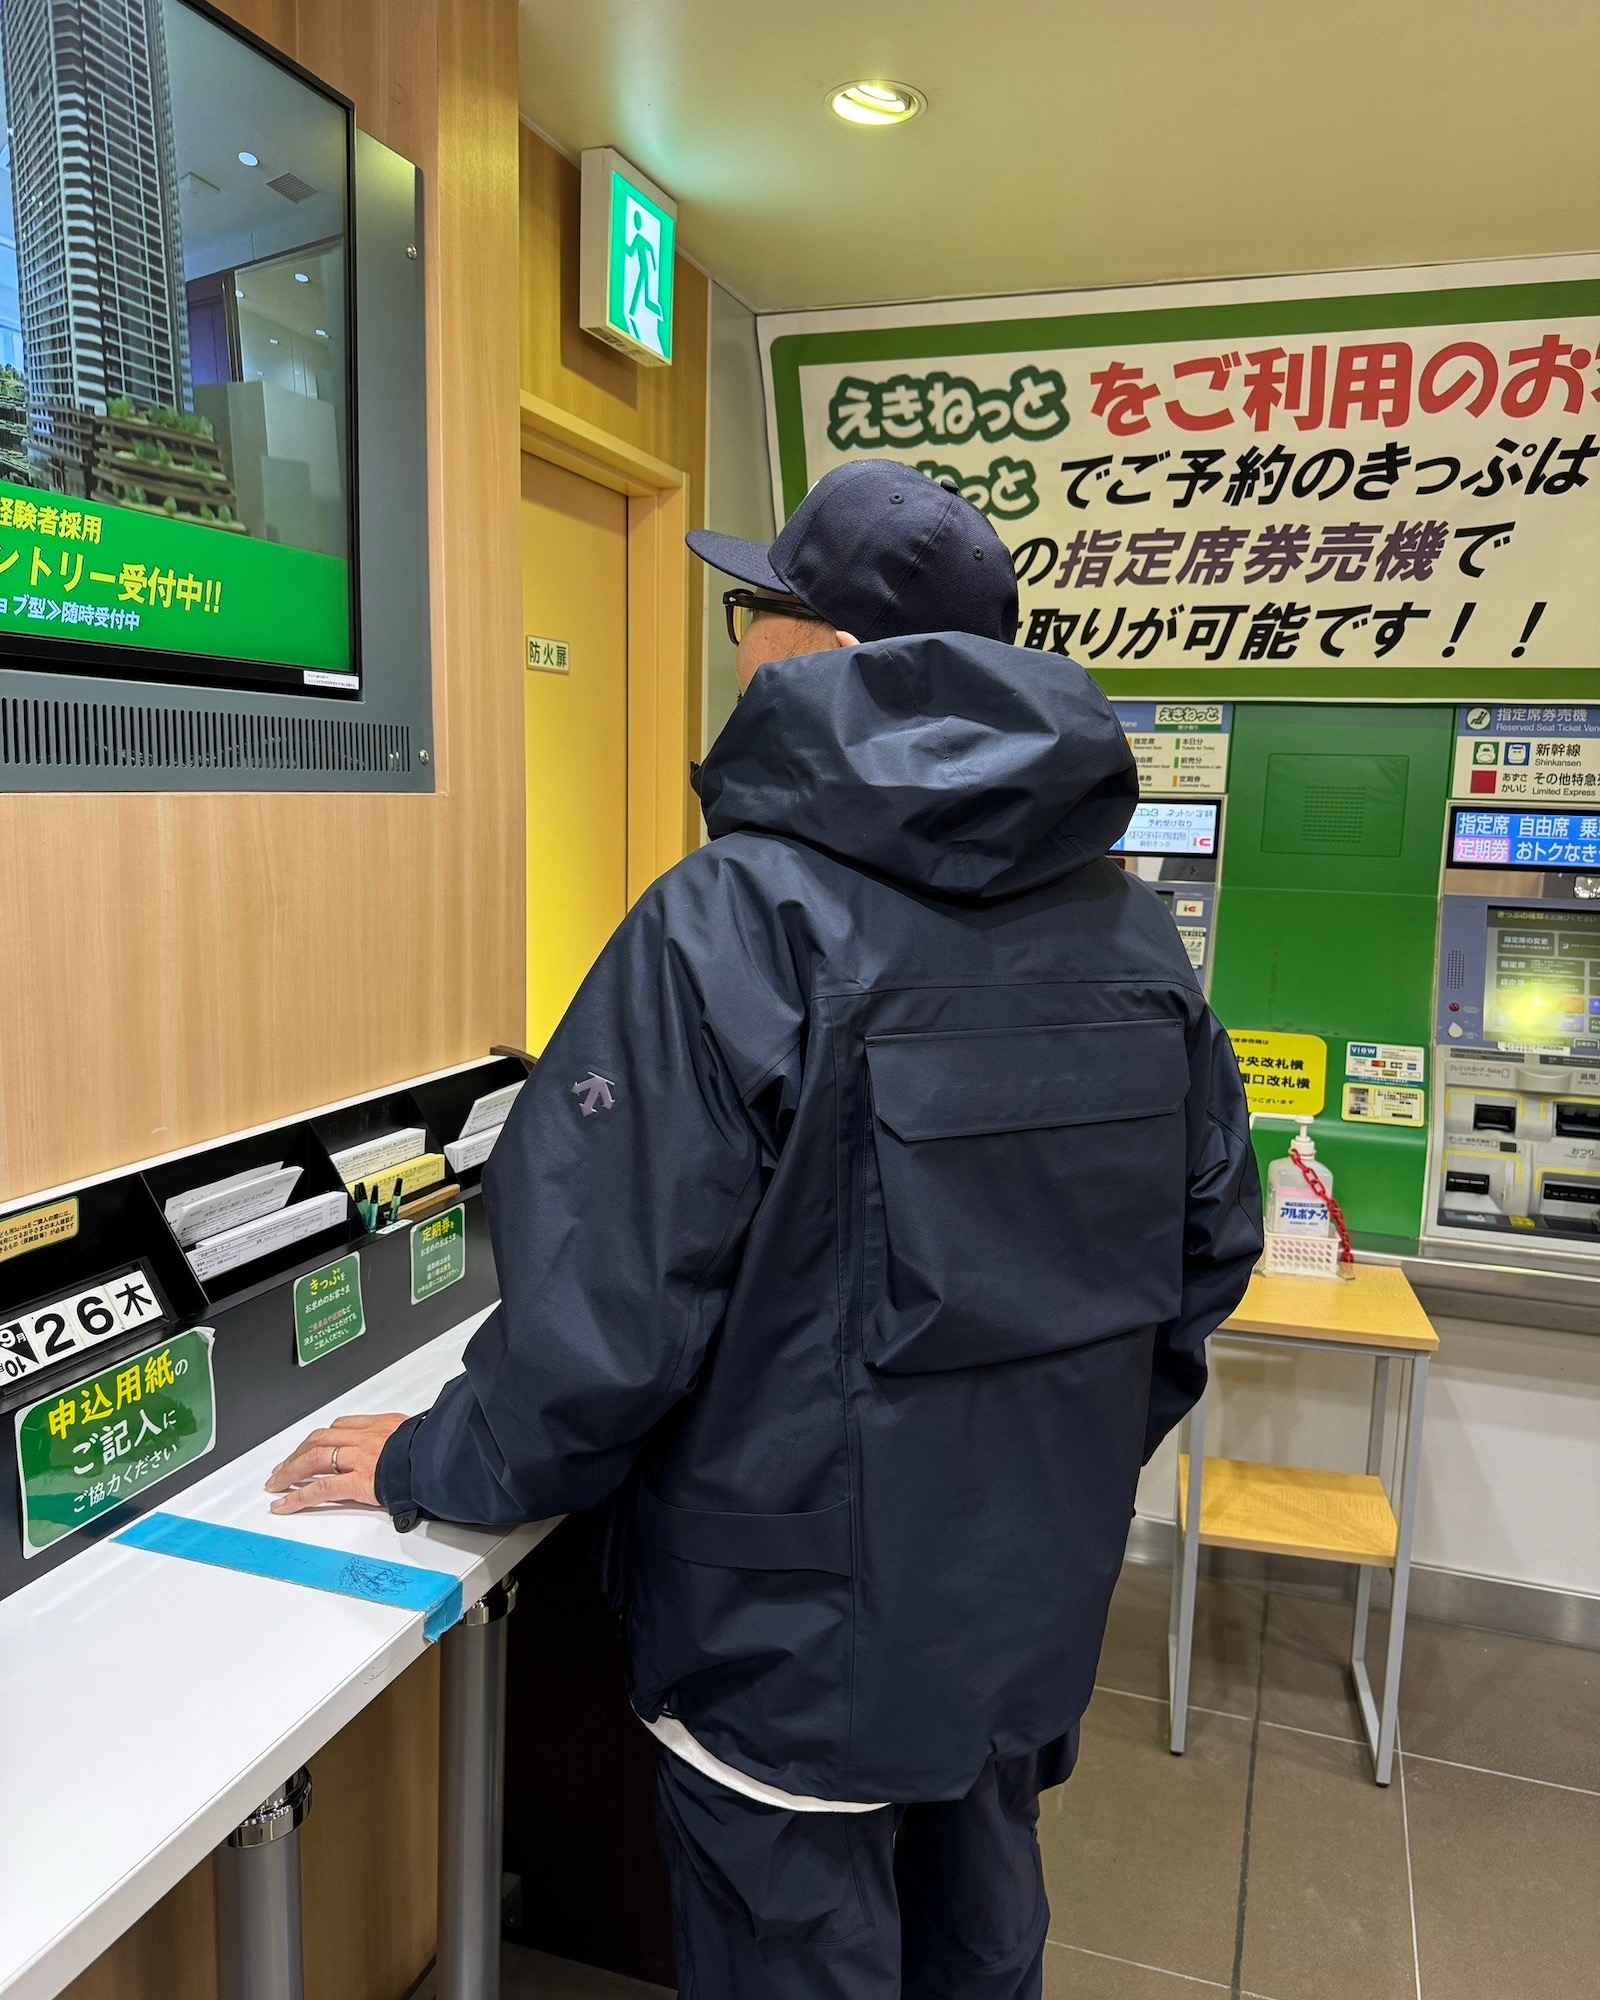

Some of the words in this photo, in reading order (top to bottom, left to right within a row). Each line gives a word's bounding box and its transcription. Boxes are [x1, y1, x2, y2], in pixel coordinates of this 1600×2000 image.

[831, 369, 1066, 446] えきねっと
[1061, 434, 1600, 509] でご予約のきっぷは
[1012, 520, 1516, 589] の指定席券売機で
[1018, 602, 1547, 660] 取りが可能です！！
[529, 641, 567, 668] 防火扉
[1158, 706, 1219, 722] えきねっと
[1496, 708, 1588, 723] 指定席券売機
[1495, 723, 1534, 732] Reserved
[1537, 724, 1555, 732] Seat
[1557, 724, 1581, 733] Ticket
[1133, 738, 1155, 746] 指定席
[1181, 738, 1203, 746] 本日分
[1535, 743, 1581, 758] 新幹線
[1534, 758, 1582, 767] Shinkansen
[1502, 773, 1528, 783] あずさ
[1501, 784, 1527, 793] かいじ
[1532, 788, 1560, 796] Limited
[1562, 788, 1596, 797] Express
[1459, 814, 1510, 835] 指定席
[1518, 816, 1570, 837] 自由席
[1457, 839, 1509, 860] 定期券
[1516, 841, 1600, 863] おトクなき
[1230, 1037, 1268, 1045] 席券売機は
[1247, 1096, 1294, 1105] つございます
[1570, 1147, 1595, 1157] おつり
[1280, 1207, 1328, 1221] アルボナース
[422, 1216, 455, 1244] 定期券を
[34, 1296, 114, 1358] 26
[115, 1283, 152, 1317] 木
[48, 1349, 189, 1440] 申込用紙の
[72, 1409, 177, 1475] ご記入に
[73, 1444, 178, 1513] ご協力ください
